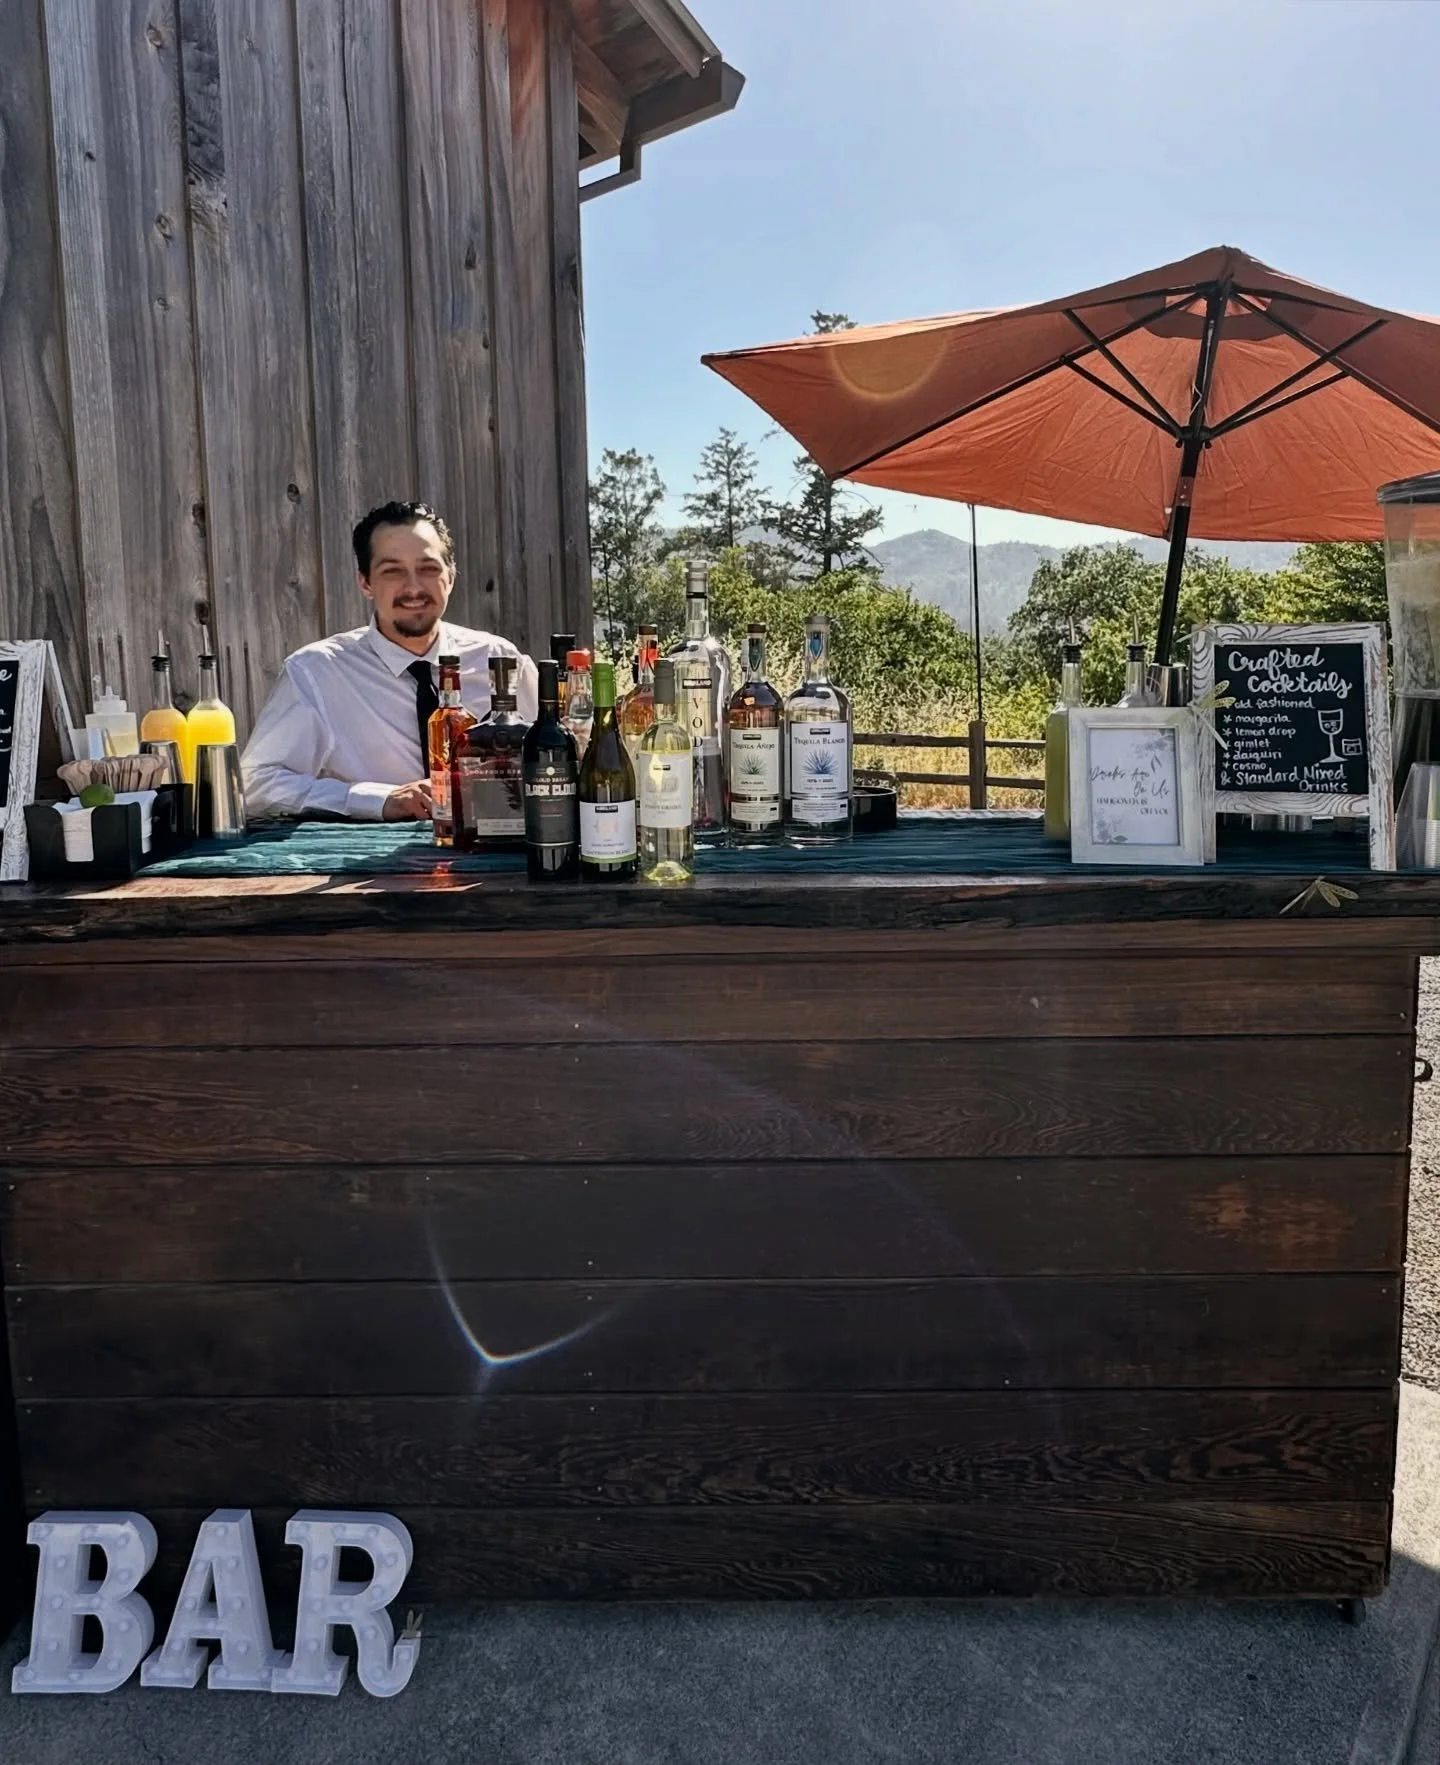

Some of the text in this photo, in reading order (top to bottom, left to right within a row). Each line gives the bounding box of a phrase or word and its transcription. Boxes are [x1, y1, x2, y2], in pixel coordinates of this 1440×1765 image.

[1228, 646, 1325, 681] Crafted
[1247, 671, 1353, 699] Cocktails
[1234, 696, 1316, 709] old fashioned
[1235, 713, 1292, 727] margarita
[1235, 726, 1297, 739] lemon drop
[1233, 738, 1271, 751] gimlet
[1233, 748, 1282, 762] daiquiri
[1233, 761, 1267, 771] cosmo
[1220, 763, 1348, 786] & Standard Mixed
[1299, 779, 1349, 793] Drinks
[11, 1508, 422, 1699] BAR
